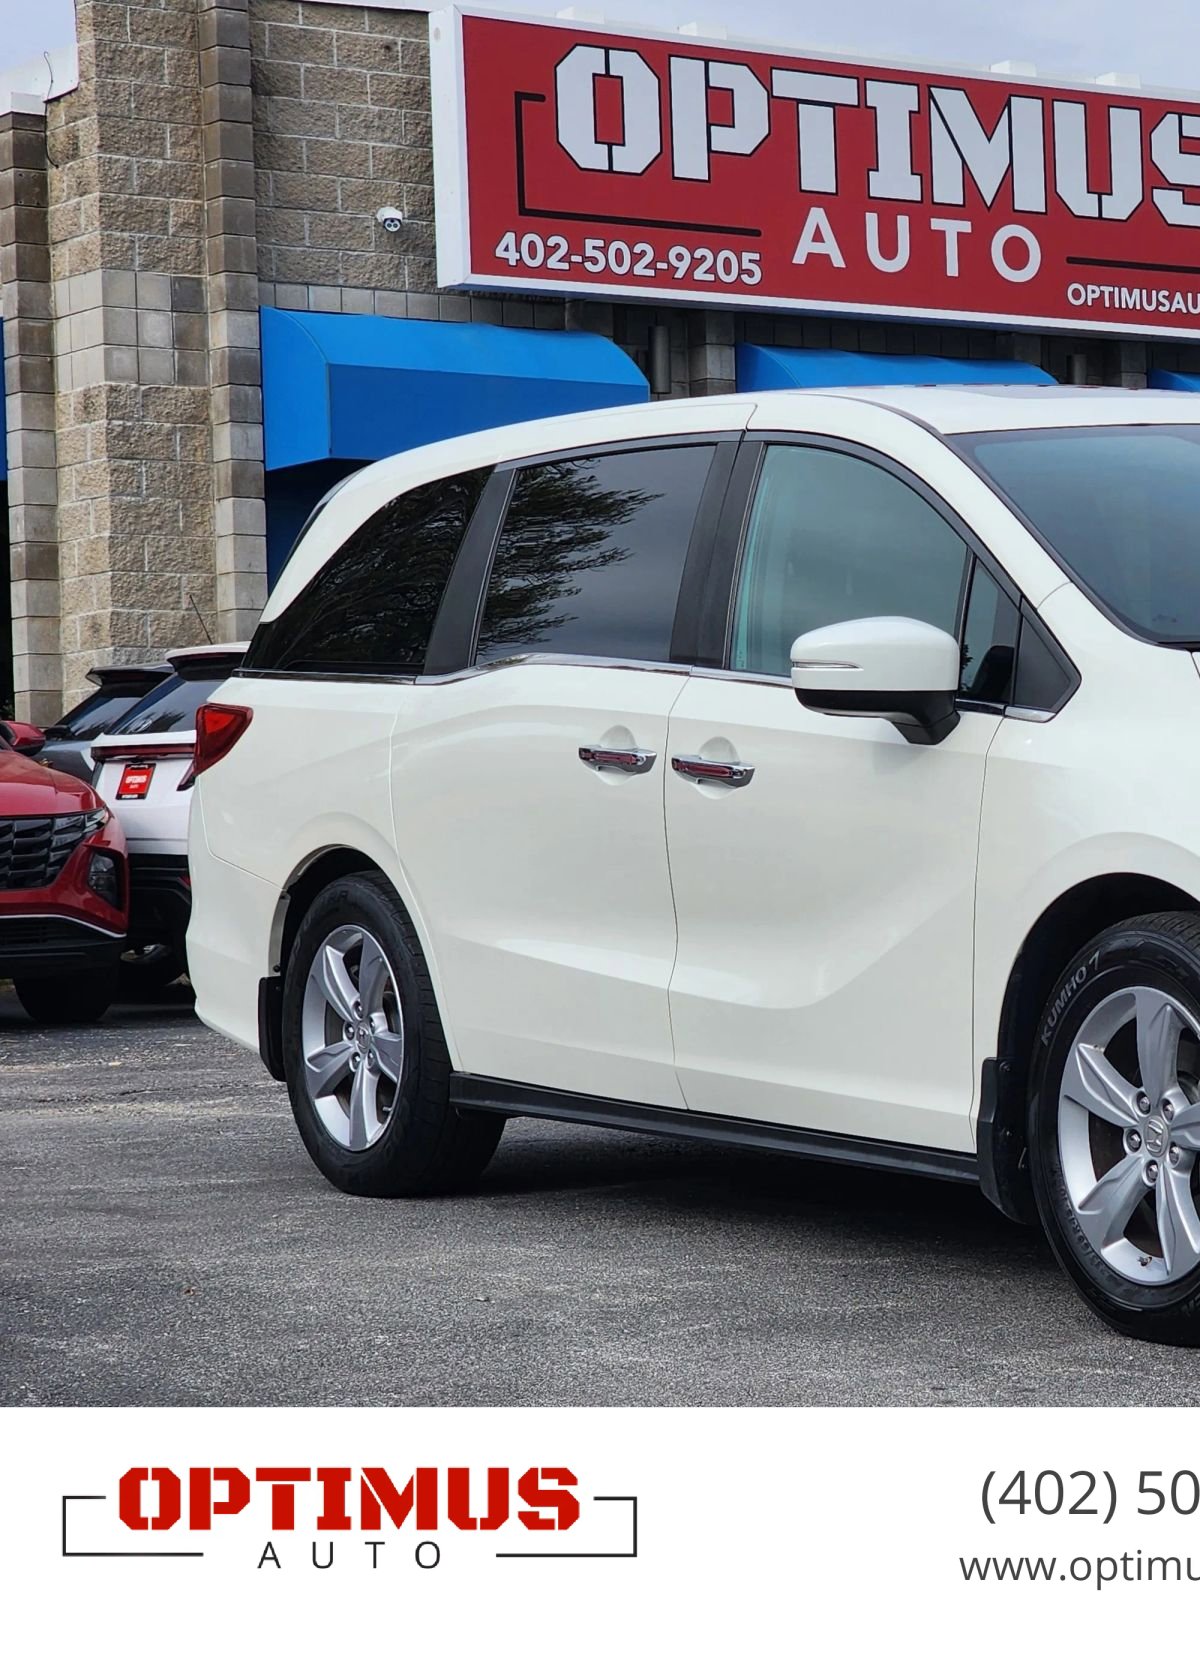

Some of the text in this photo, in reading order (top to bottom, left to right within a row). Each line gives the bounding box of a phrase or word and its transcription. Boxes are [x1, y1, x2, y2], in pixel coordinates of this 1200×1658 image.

[494, 230, 763, 286] 402-502-9205
[791, 207, 1042, 283] AUTO
[1041, 966, 1087, 1046] KUMHO
